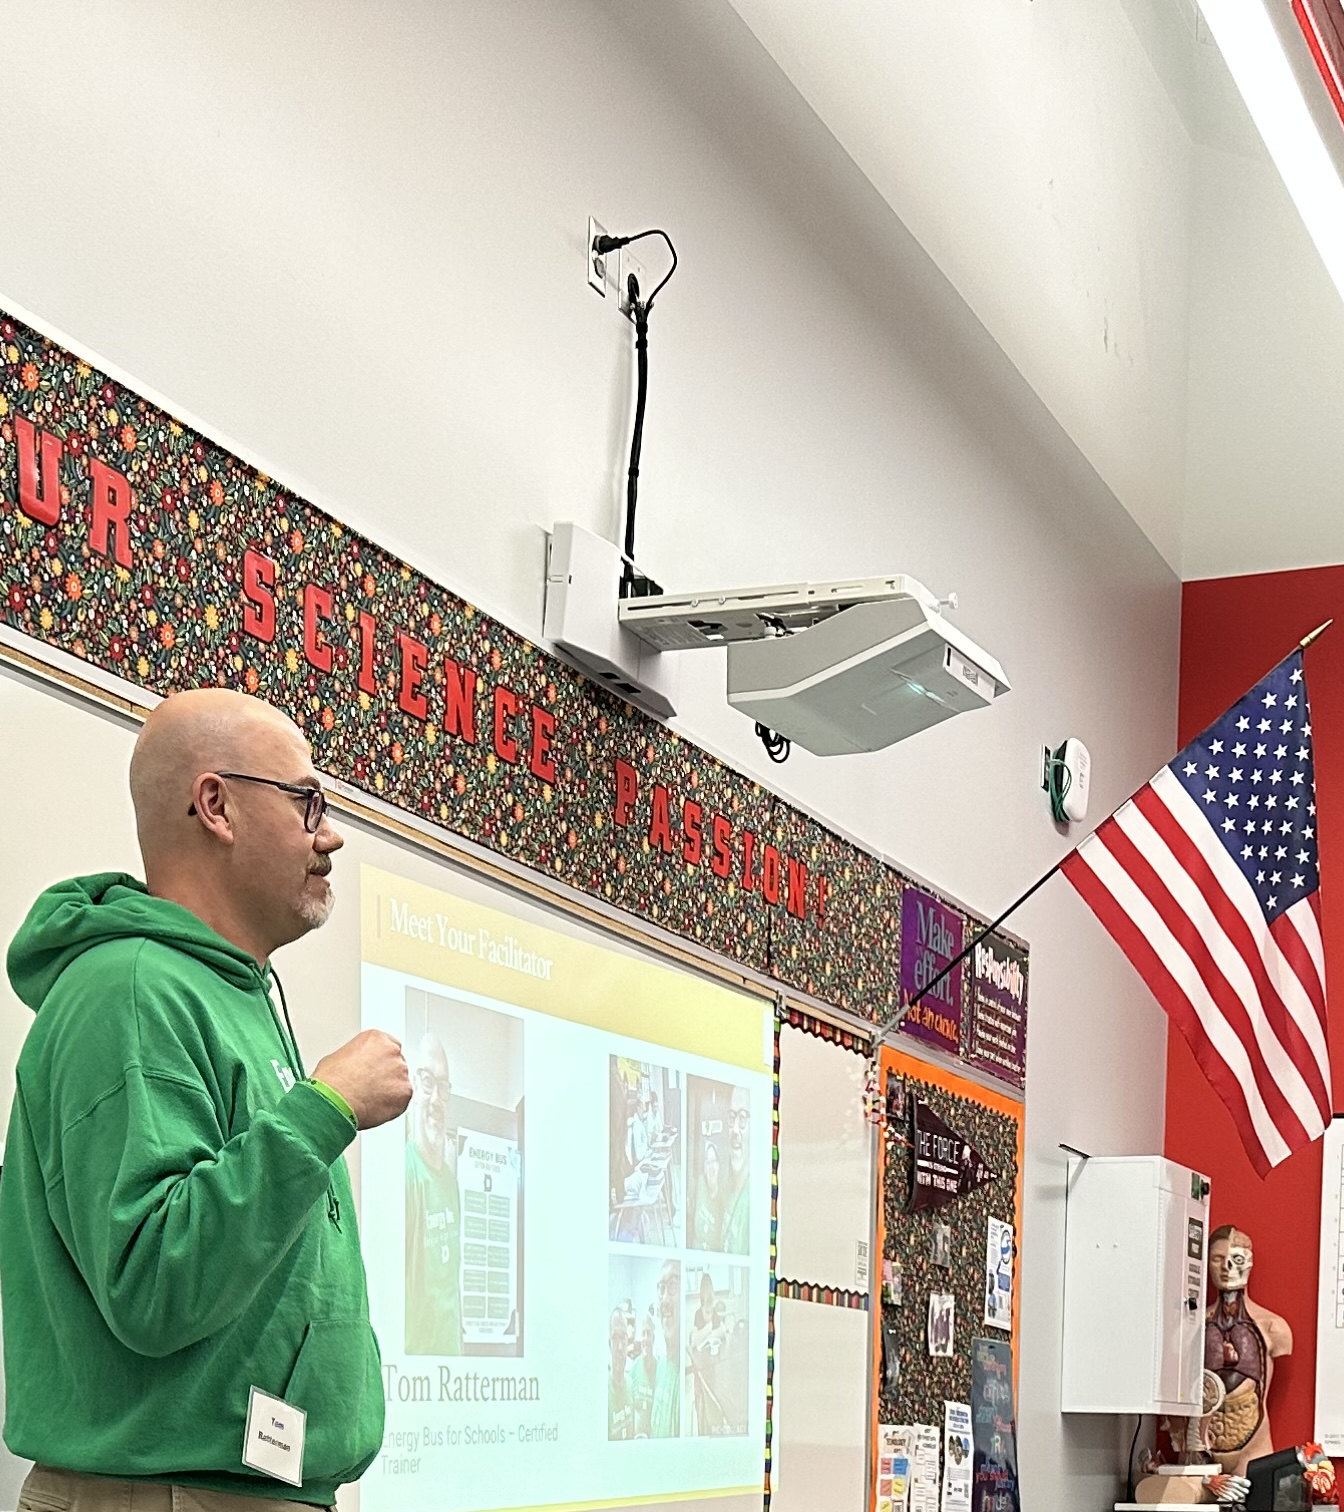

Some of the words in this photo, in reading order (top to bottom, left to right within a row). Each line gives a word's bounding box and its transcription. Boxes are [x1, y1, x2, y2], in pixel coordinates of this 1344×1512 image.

[241, 547, 556, 784] SCIENCE
[614, 758, 832, 929] PASSION!
[390, 898, 433, 943] Meet
[436, 913, 475, 955] Your
[478, 928, 553, 980] Facilitator
[916, 900, 954, 960] Make
[382, 1364, 432, 1402] Tom
[438, 1365, 540, 1402] Ratterman
[423, 1426, 443, 1446] Bus
[446, 1425, 461, 1445] for
[464, 1424, 505, 1445] Schools
[518, 1422, 558, 1442] Certified
[381, 1455, 421, 1475] Trainer
